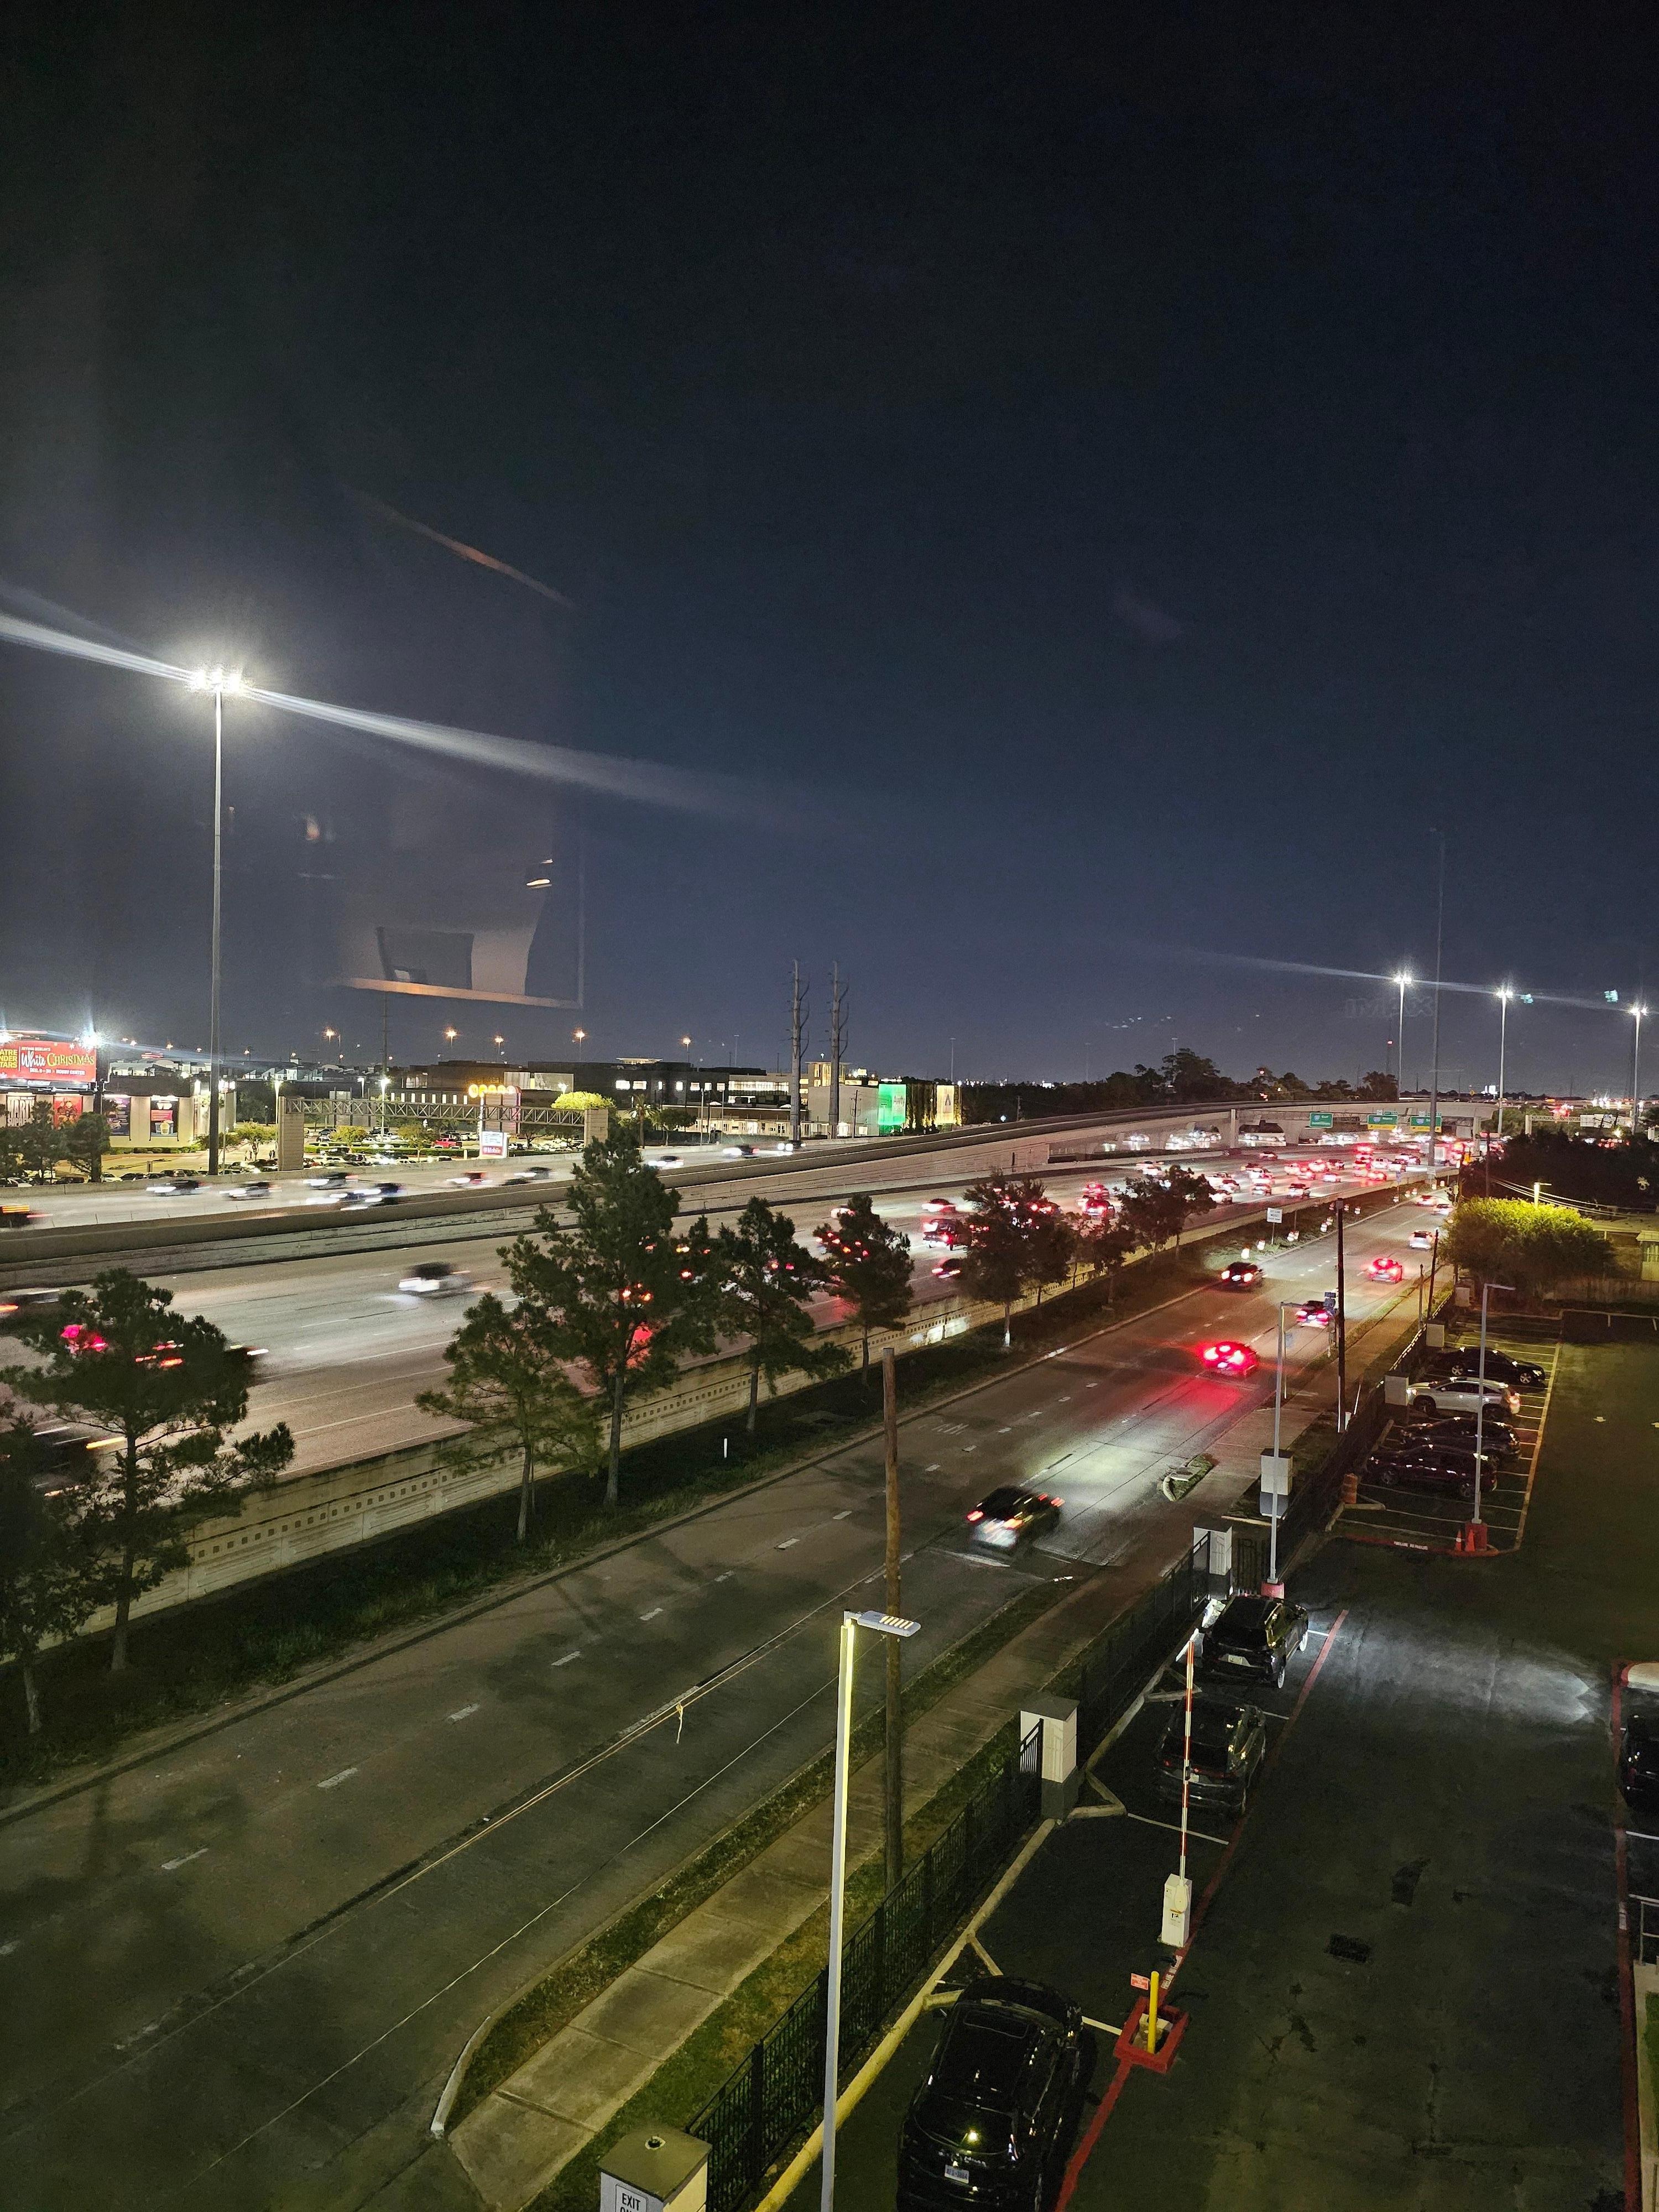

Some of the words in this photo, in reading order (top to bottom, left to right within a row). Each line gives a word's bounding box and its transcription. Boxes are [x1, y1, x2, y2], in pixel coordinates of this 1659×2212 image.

[21, 1051, 46, 1067] White
[46, 1052, 95, 1067] CHRISTMAS
[622, 2193, 641, 2211] EXIT
